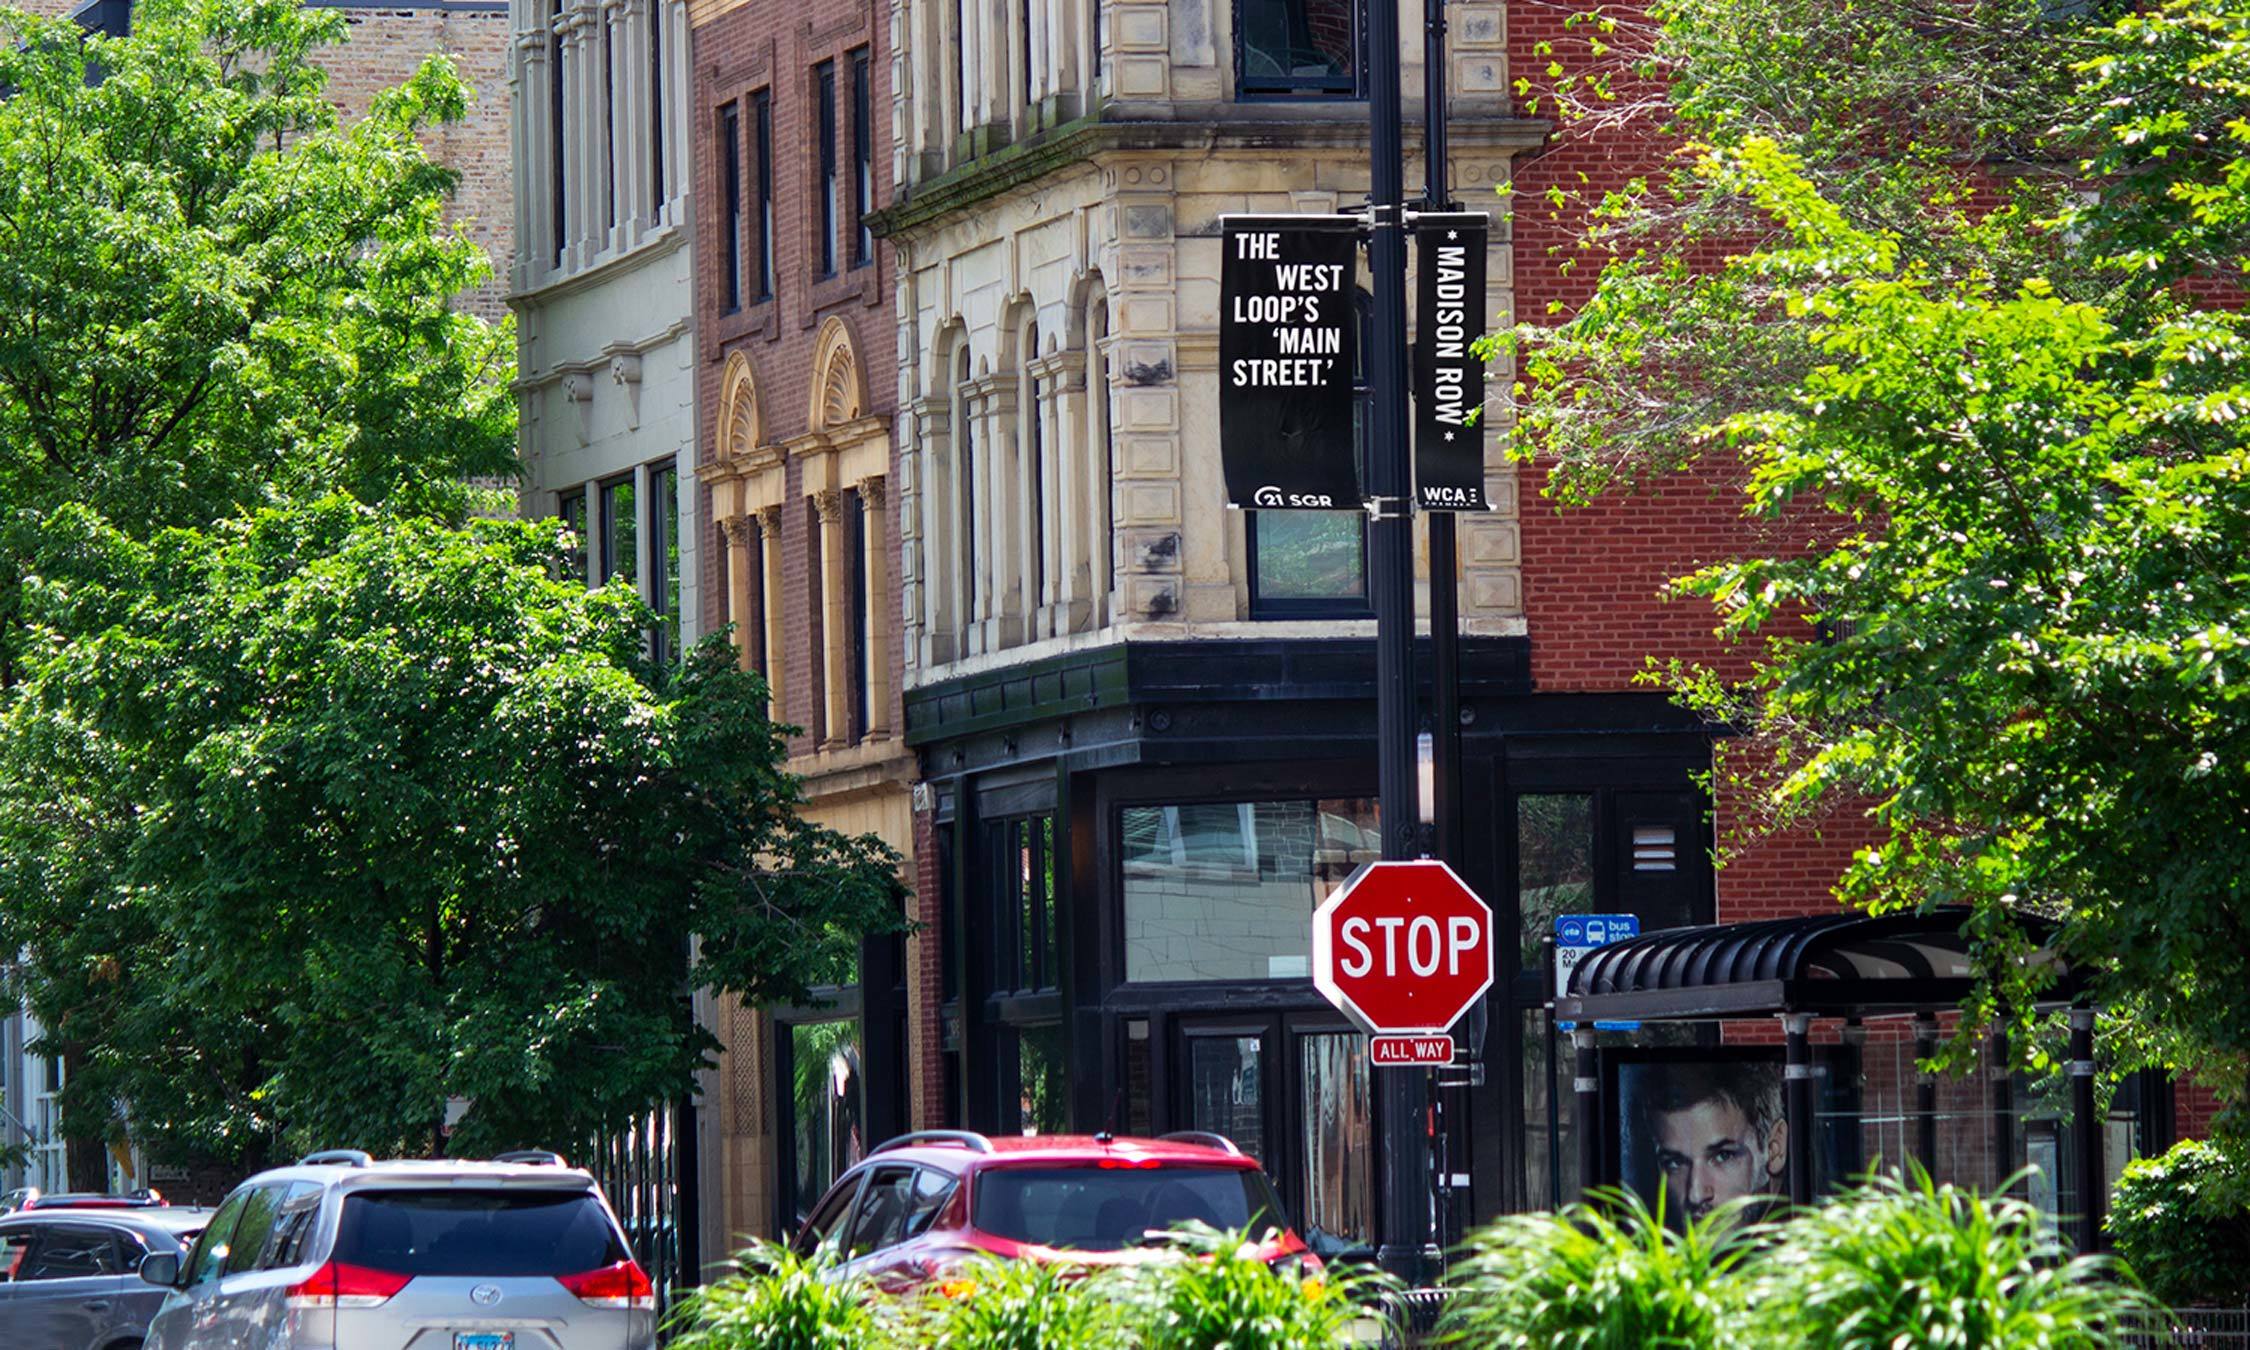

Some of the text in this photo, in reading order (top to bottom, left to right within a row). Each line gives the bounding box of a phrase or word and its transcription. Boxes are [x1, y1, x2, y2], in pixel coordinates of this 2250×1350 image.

[1234, 233, 1280, 260] THE
[1275, 264, 1344, 292] WEST
[1234, 296, 1319, 323] LOOP’S
[1435, 246, 1465, 425] MADISON ROW
[1289, 494, 1332, 507] SGR
[1423, 487, 1466, 502] WCA
[1609, 920, 1630, 931] bus
[1340, 915, 1480, 978] STOP
[1562, 949, 1576, 959] 20
[1380, 1041, 1445, 1058] ALL WAY
